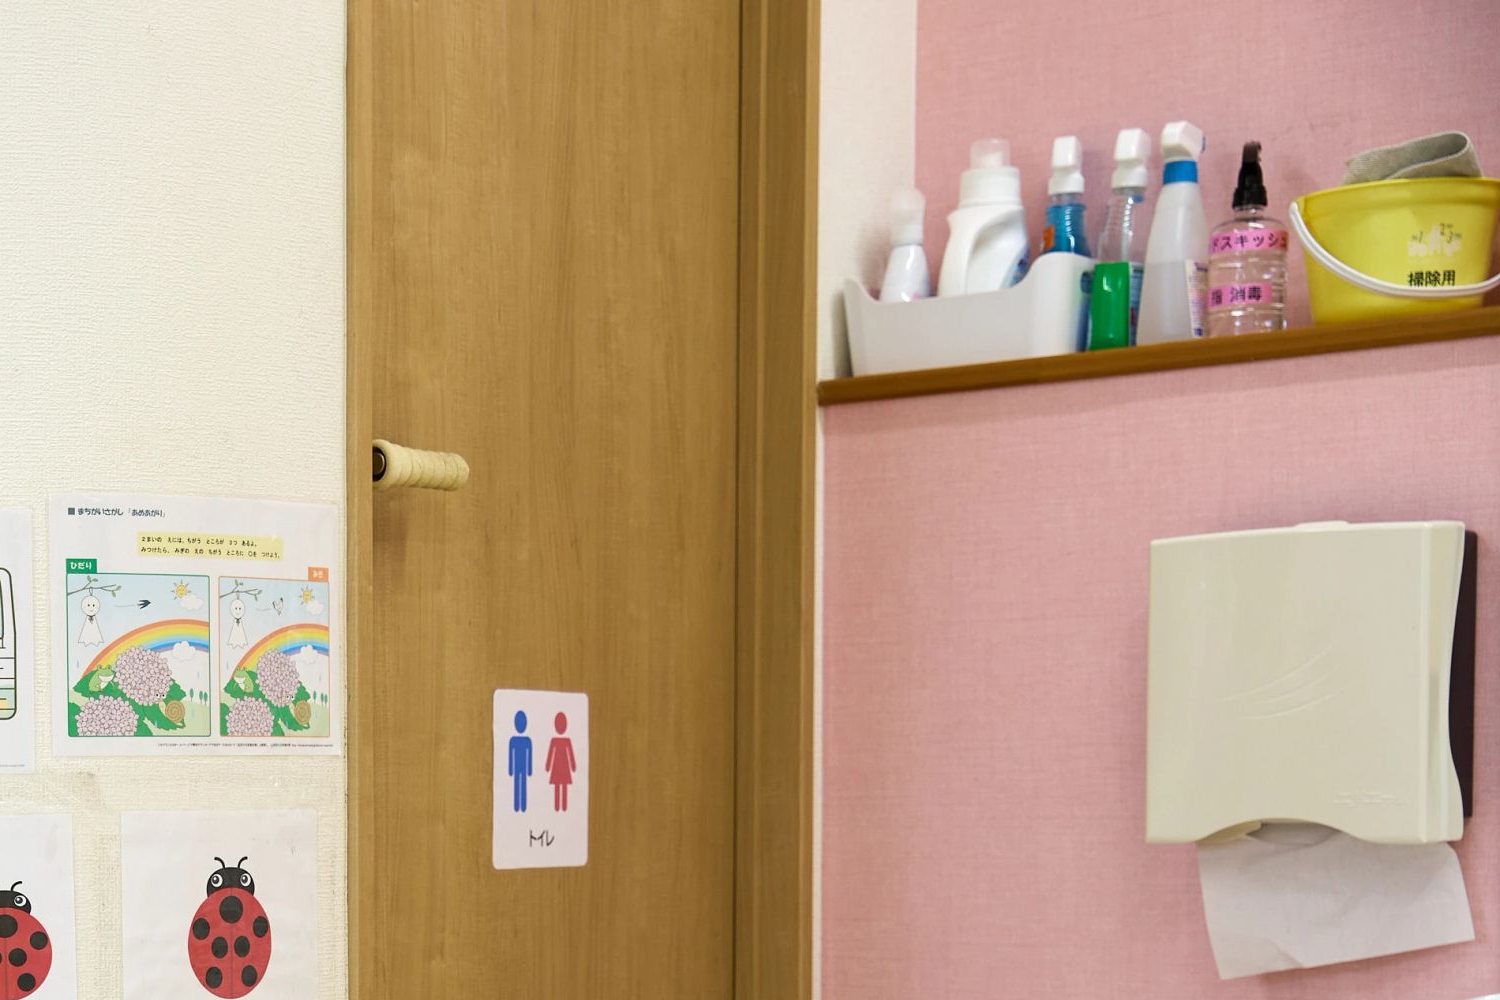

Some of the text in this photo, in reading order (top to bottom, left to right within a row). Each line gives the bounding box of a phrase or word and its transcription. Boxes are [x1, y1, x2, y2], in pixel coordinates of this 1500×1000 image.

[1408, 270, 1456, 287] 掃除用
[1229, 286, 1262, 303] 消毒
[70, 561, 92, 570] ひだり
[529, 829, 555, 847] トイレ
